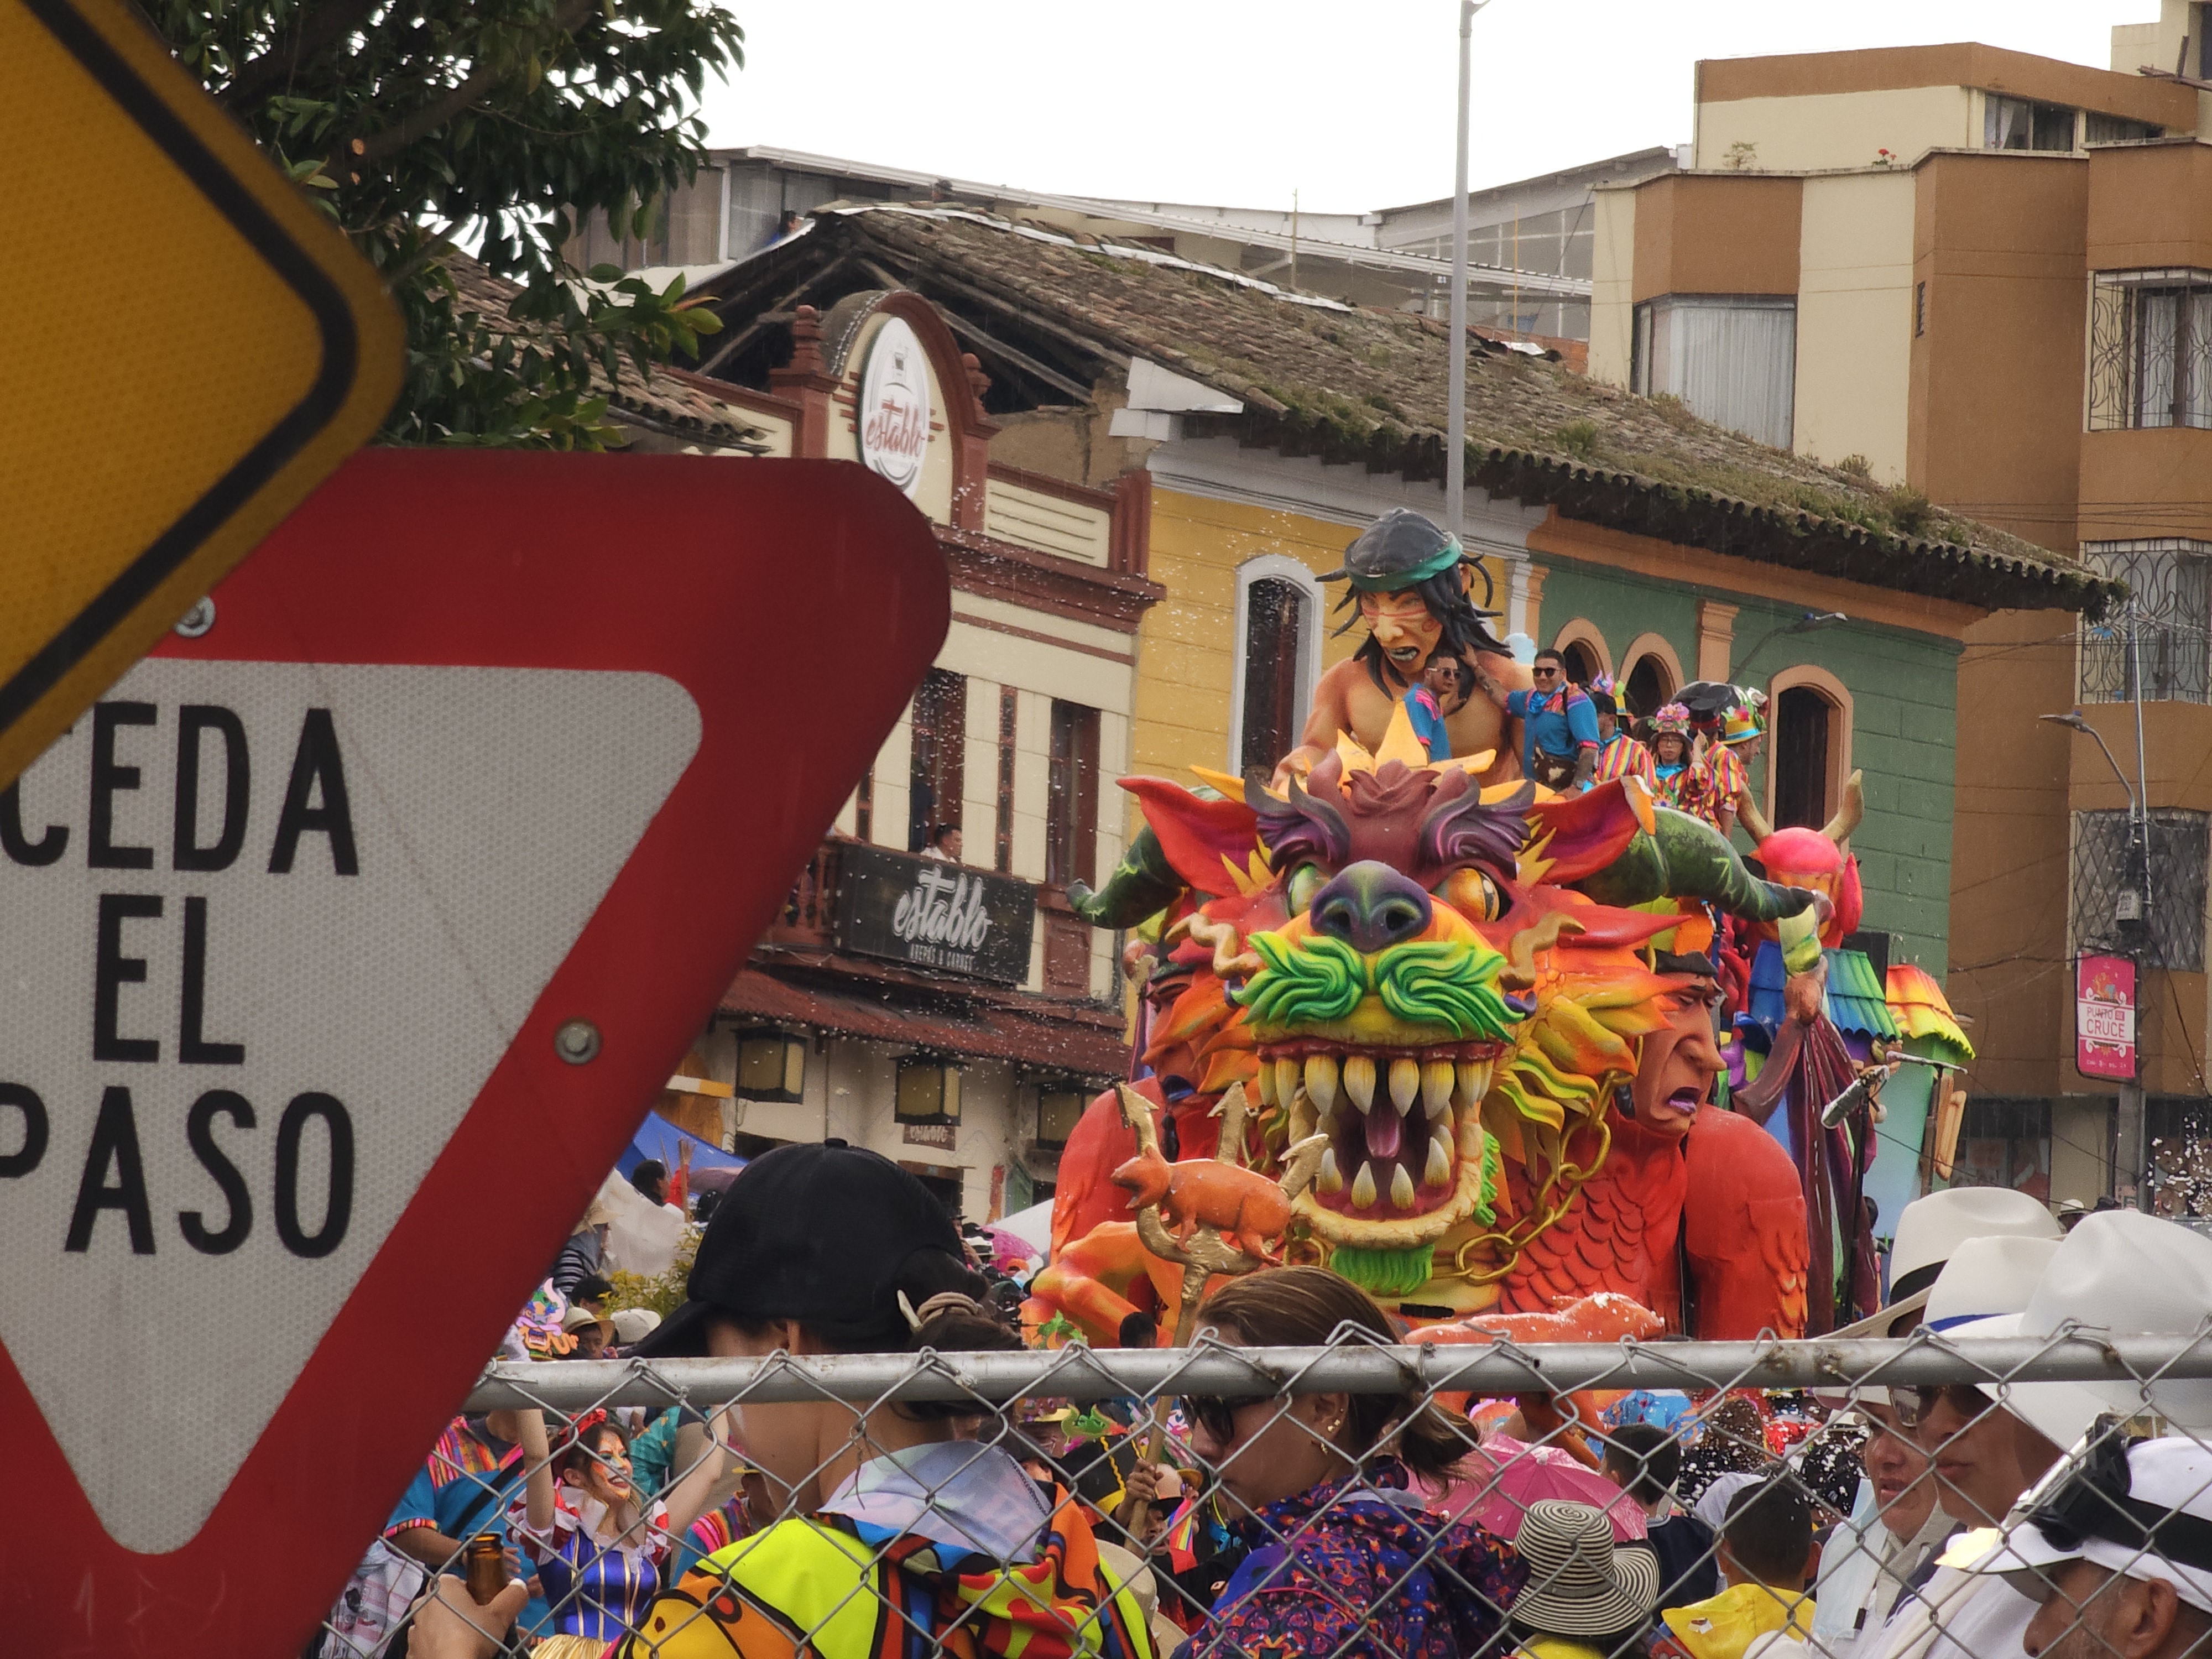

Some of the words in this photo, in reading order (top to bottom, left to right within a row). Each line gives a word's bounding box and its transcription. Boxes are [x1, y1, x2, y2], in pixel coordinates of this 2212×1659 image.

[865, 395, 925, 458] establo
[892, 864, 993, 952] establo
[93, 894, 246, 1065] EL
[2086, 1006, 2113, 1020] PUNTO
[2086, 1018, 2125, 1038] CRUCE
